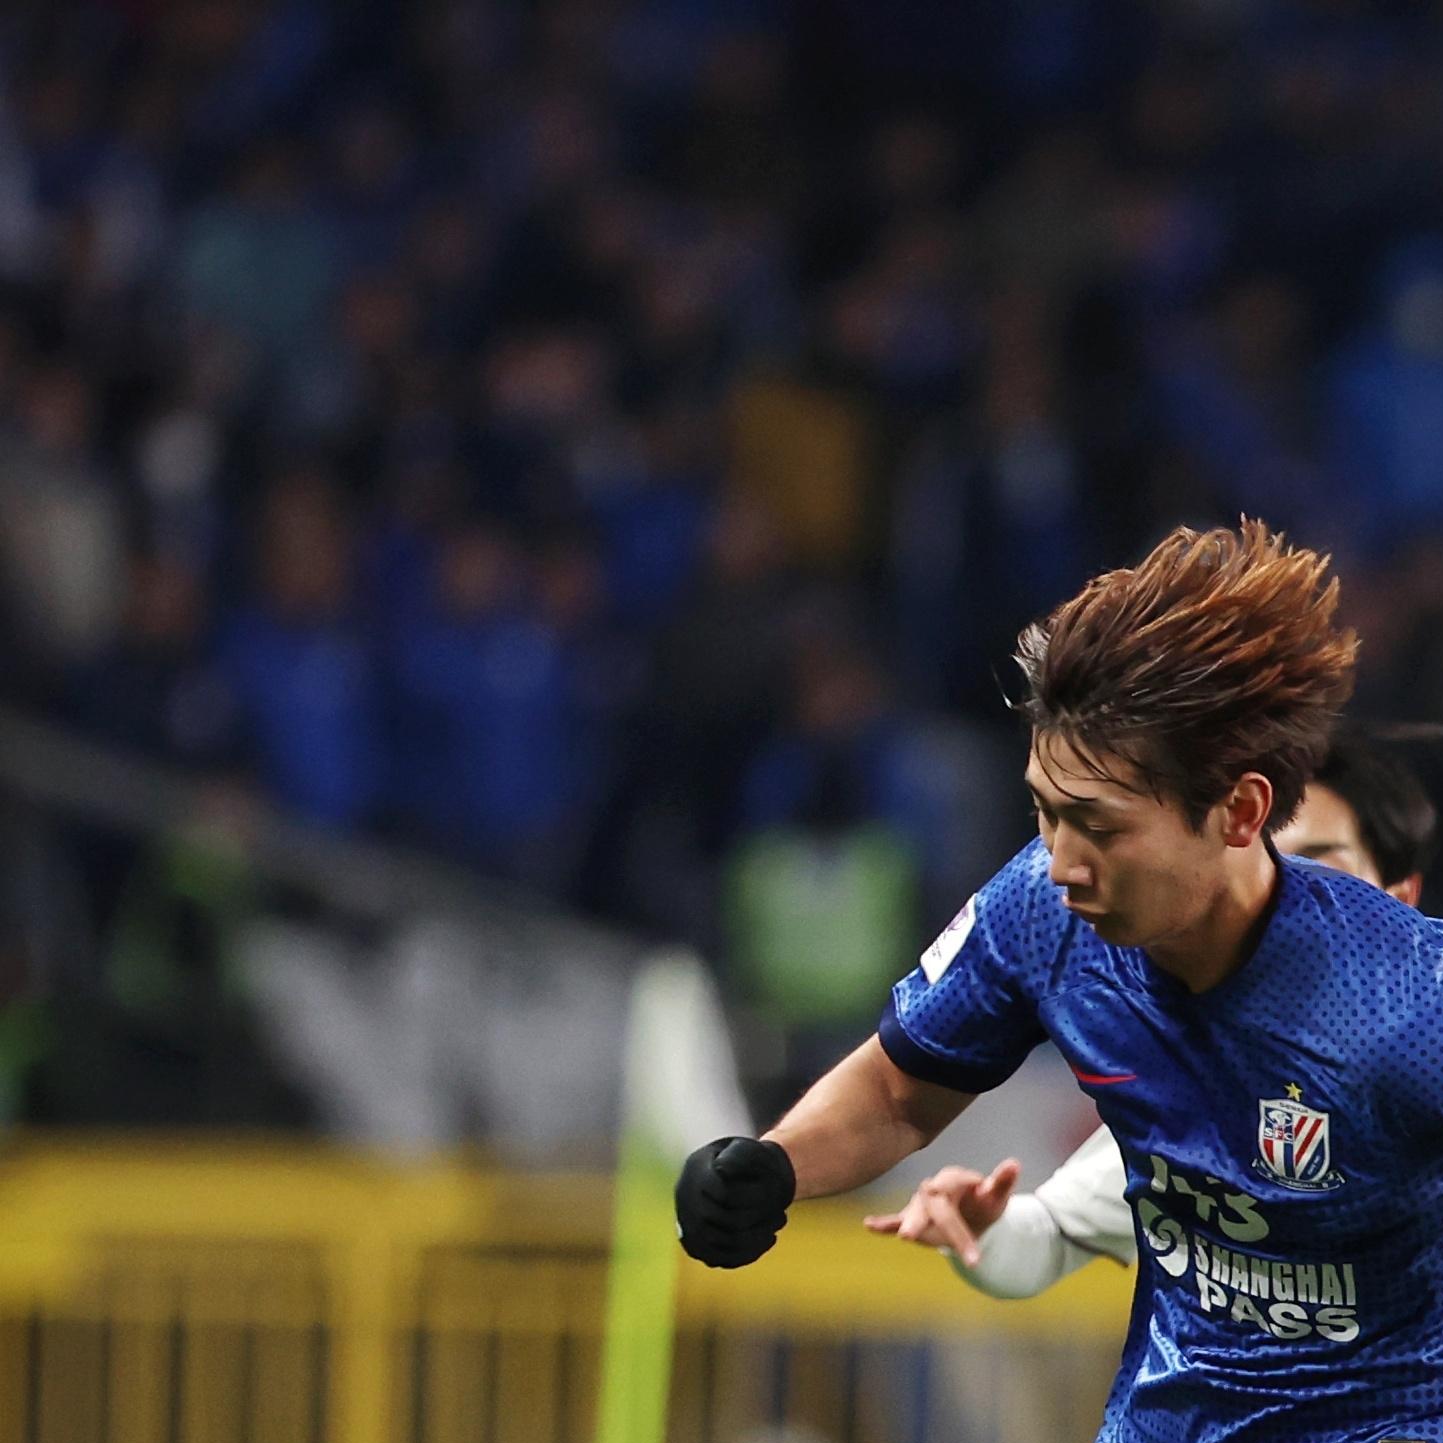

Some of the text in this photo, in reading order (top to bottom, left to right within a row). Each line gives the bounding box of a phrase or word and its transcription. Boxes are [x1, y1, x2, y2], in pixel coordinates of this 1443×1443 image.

[1263, 1126, 1294, 1144] SFC
[1193, 1233, 1357, 1306] SHANGHAI
[1196, 1271, 1360, 1343] PASS
